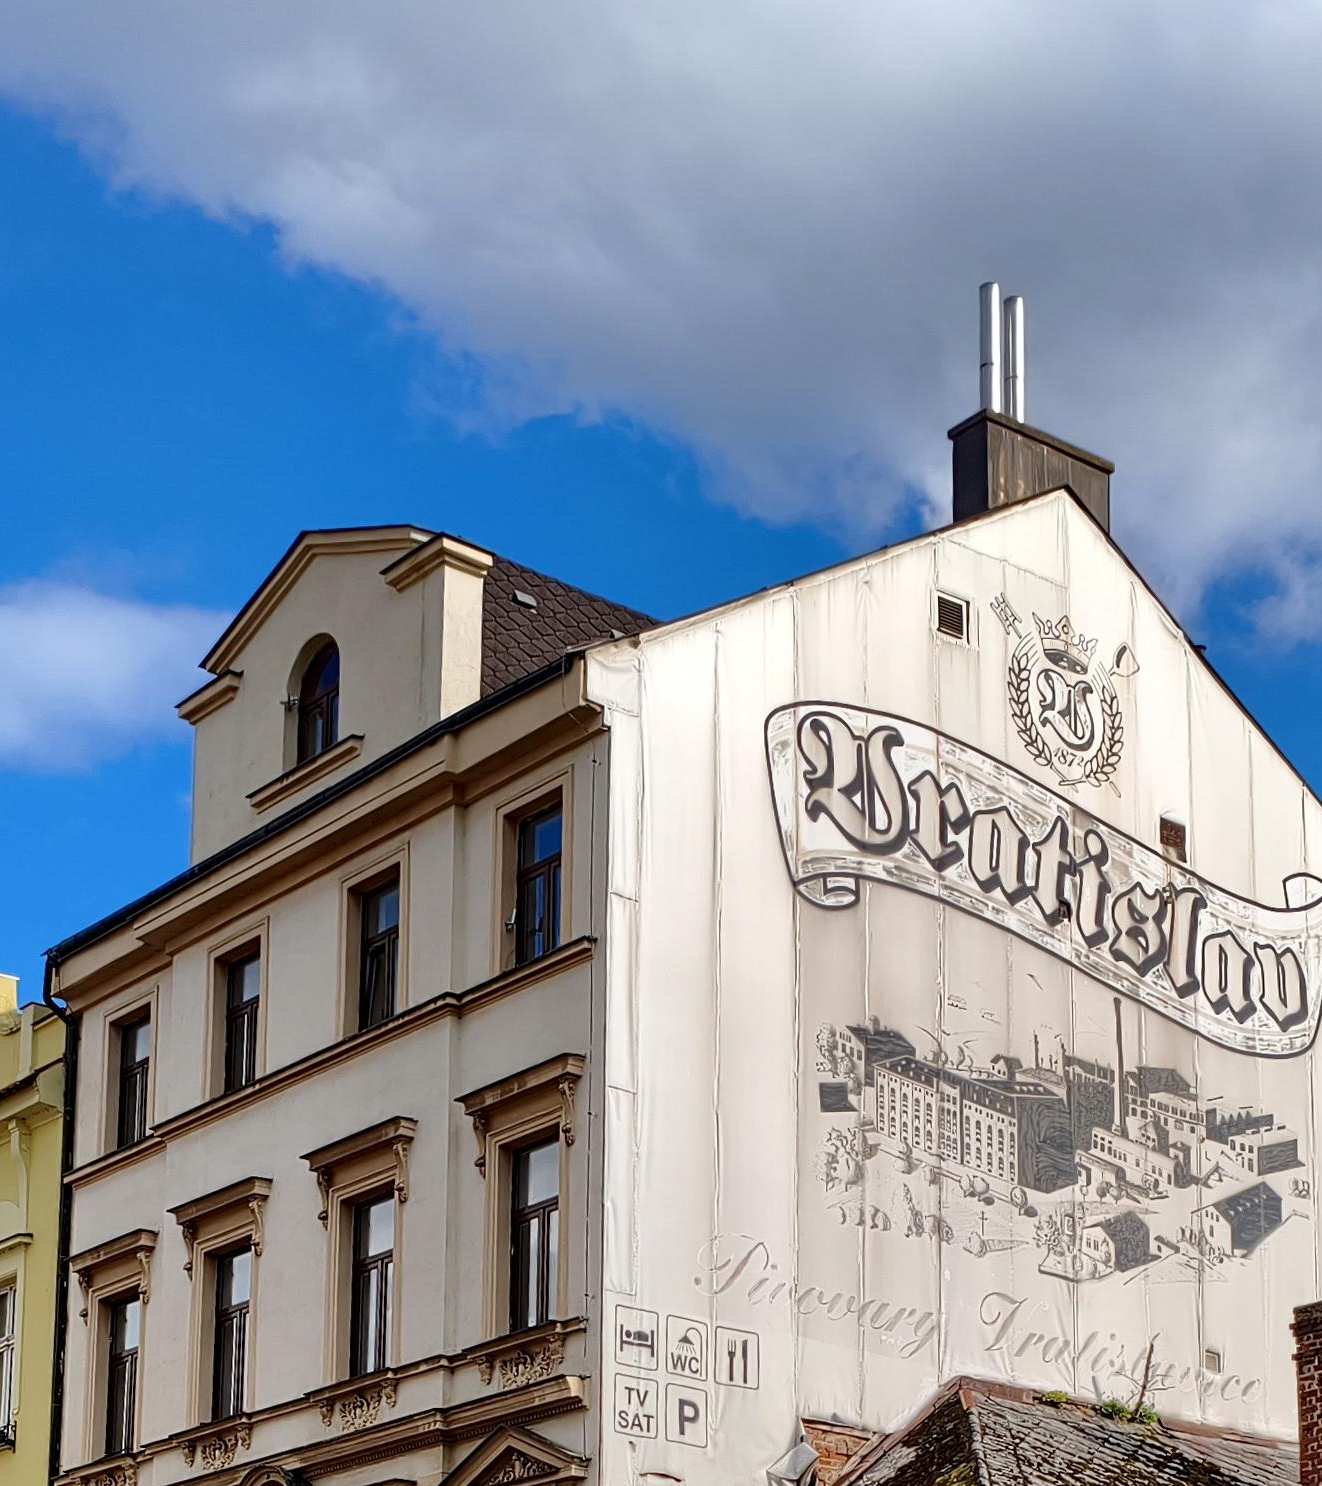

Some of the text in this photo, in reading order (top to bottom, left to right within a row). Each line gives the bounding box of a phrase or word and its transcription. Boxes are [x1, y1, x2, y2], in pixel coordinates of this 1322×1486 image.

[1053, 746, 1085, 768] 1872
[797, 711, 1309, 1034] Vratislav
[671, 1352, 699, 1374] WC
[624, 1386, 648, 1407] TV
[618, 1410, 654, 1433] SAT
[678, 1398, 700, 1436] P
